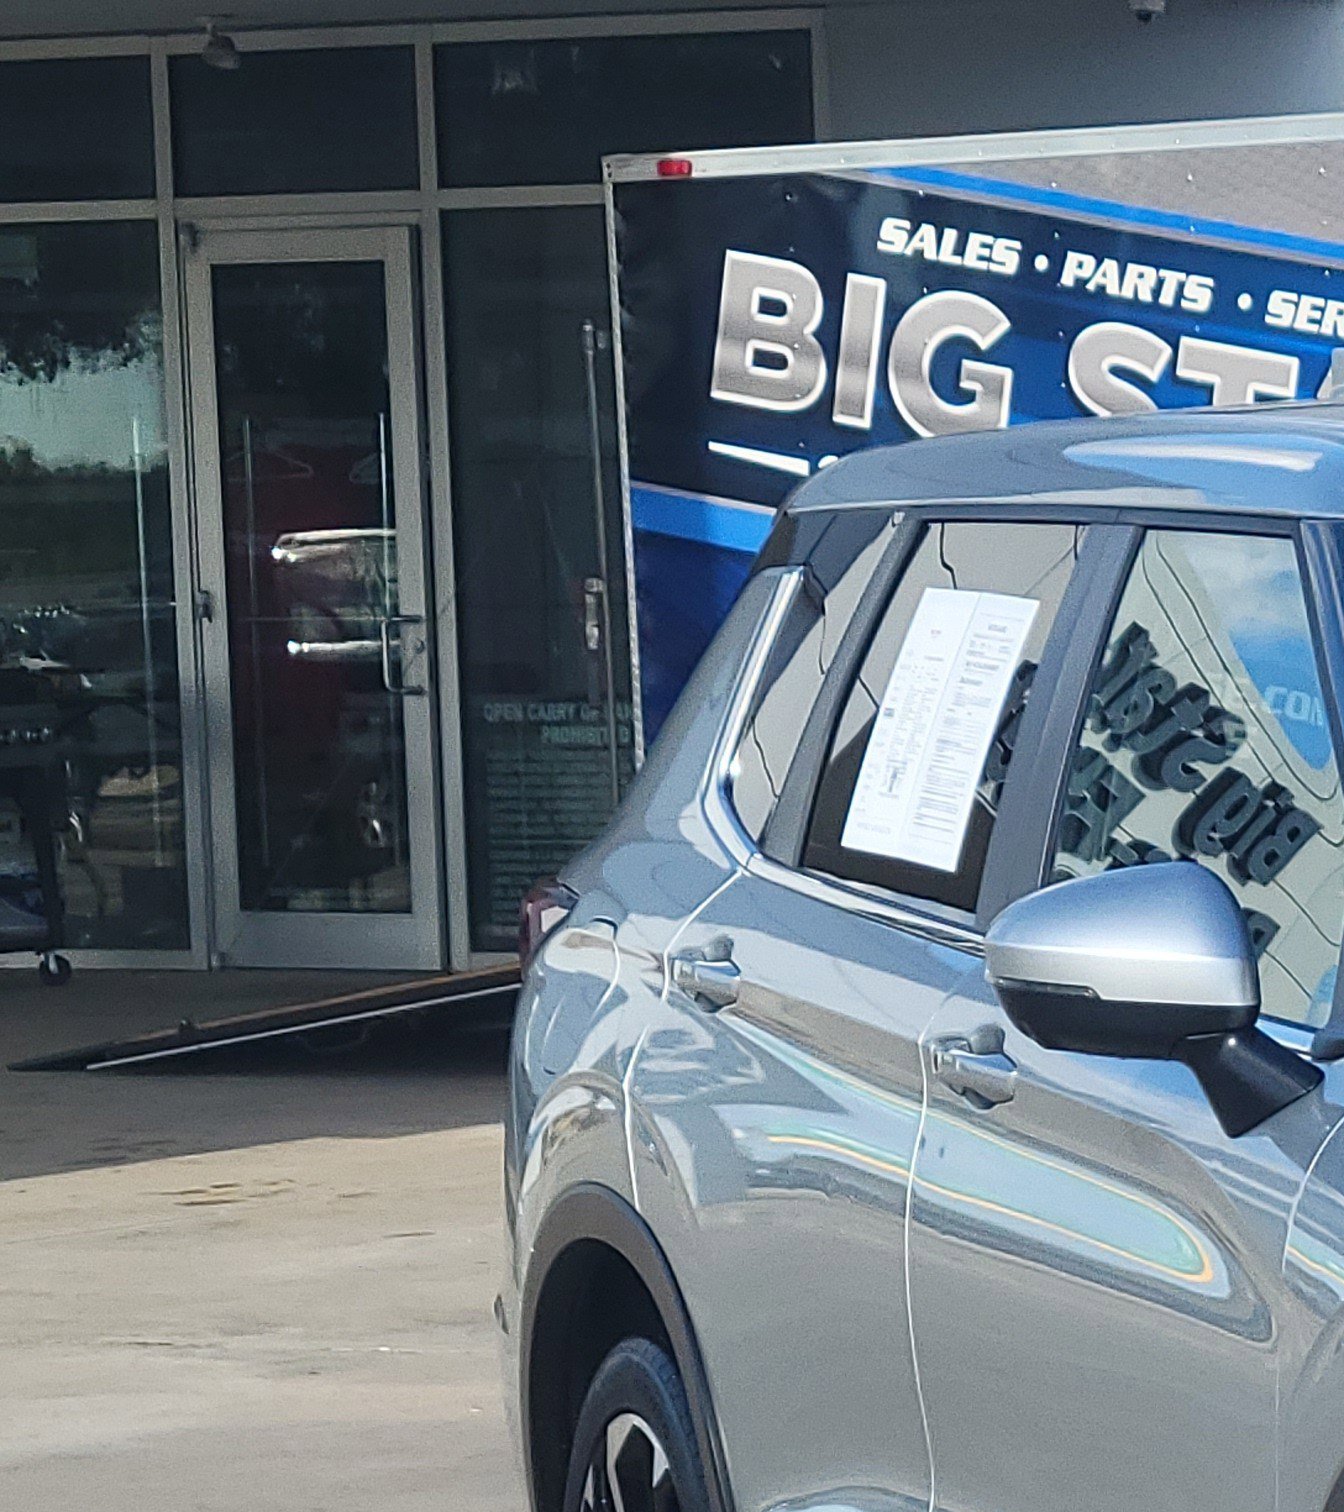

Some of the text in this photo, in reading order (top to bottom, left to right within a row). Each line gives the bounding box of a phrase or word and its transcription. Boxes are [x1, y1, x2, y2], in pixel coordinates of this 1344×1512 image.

[876, 217, 1022, 276] SALES
[1060, 250, 1214, 312] PARTS
[709, 248, 1013, 438] BIG
